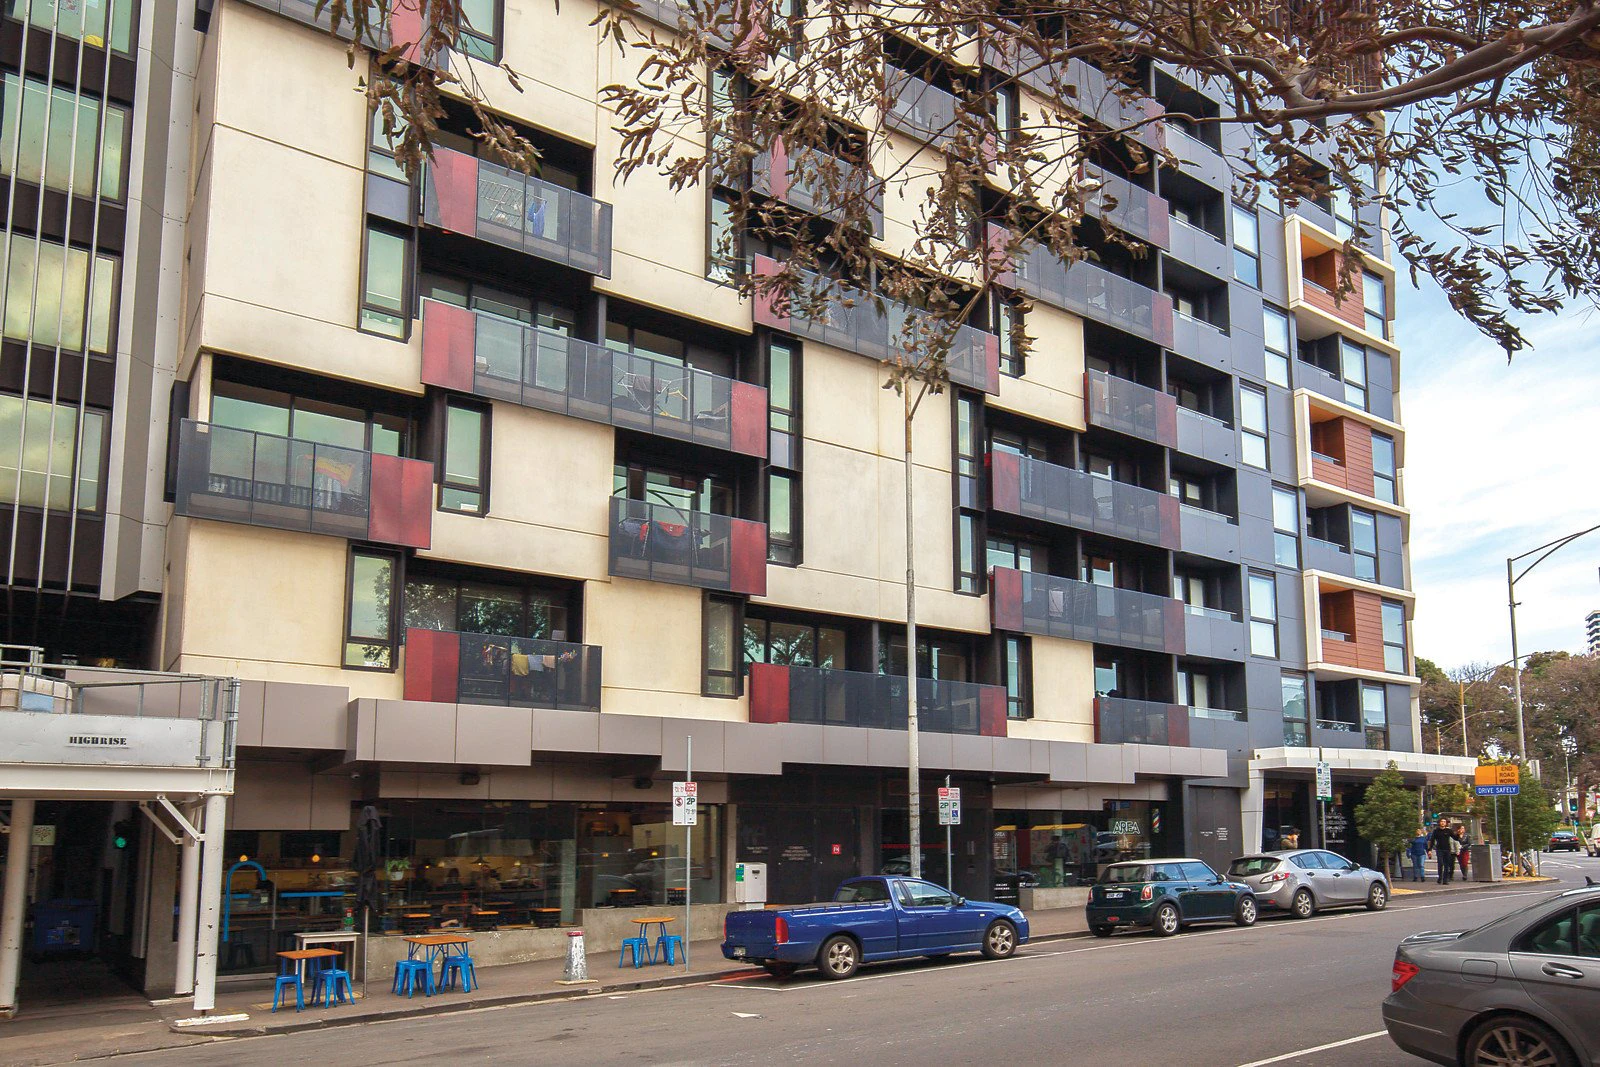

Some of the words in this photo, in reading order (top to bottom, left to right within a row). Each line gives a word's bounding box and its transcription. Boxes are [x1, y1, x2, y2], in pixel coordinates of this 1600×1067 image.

[69, 736, 127, 746] HIGHRISE
[1495, 786, 1517, 794] SAFELY
[686, 797, 696, 805] 2P
[1112, 820, 1141, 835] AREA
